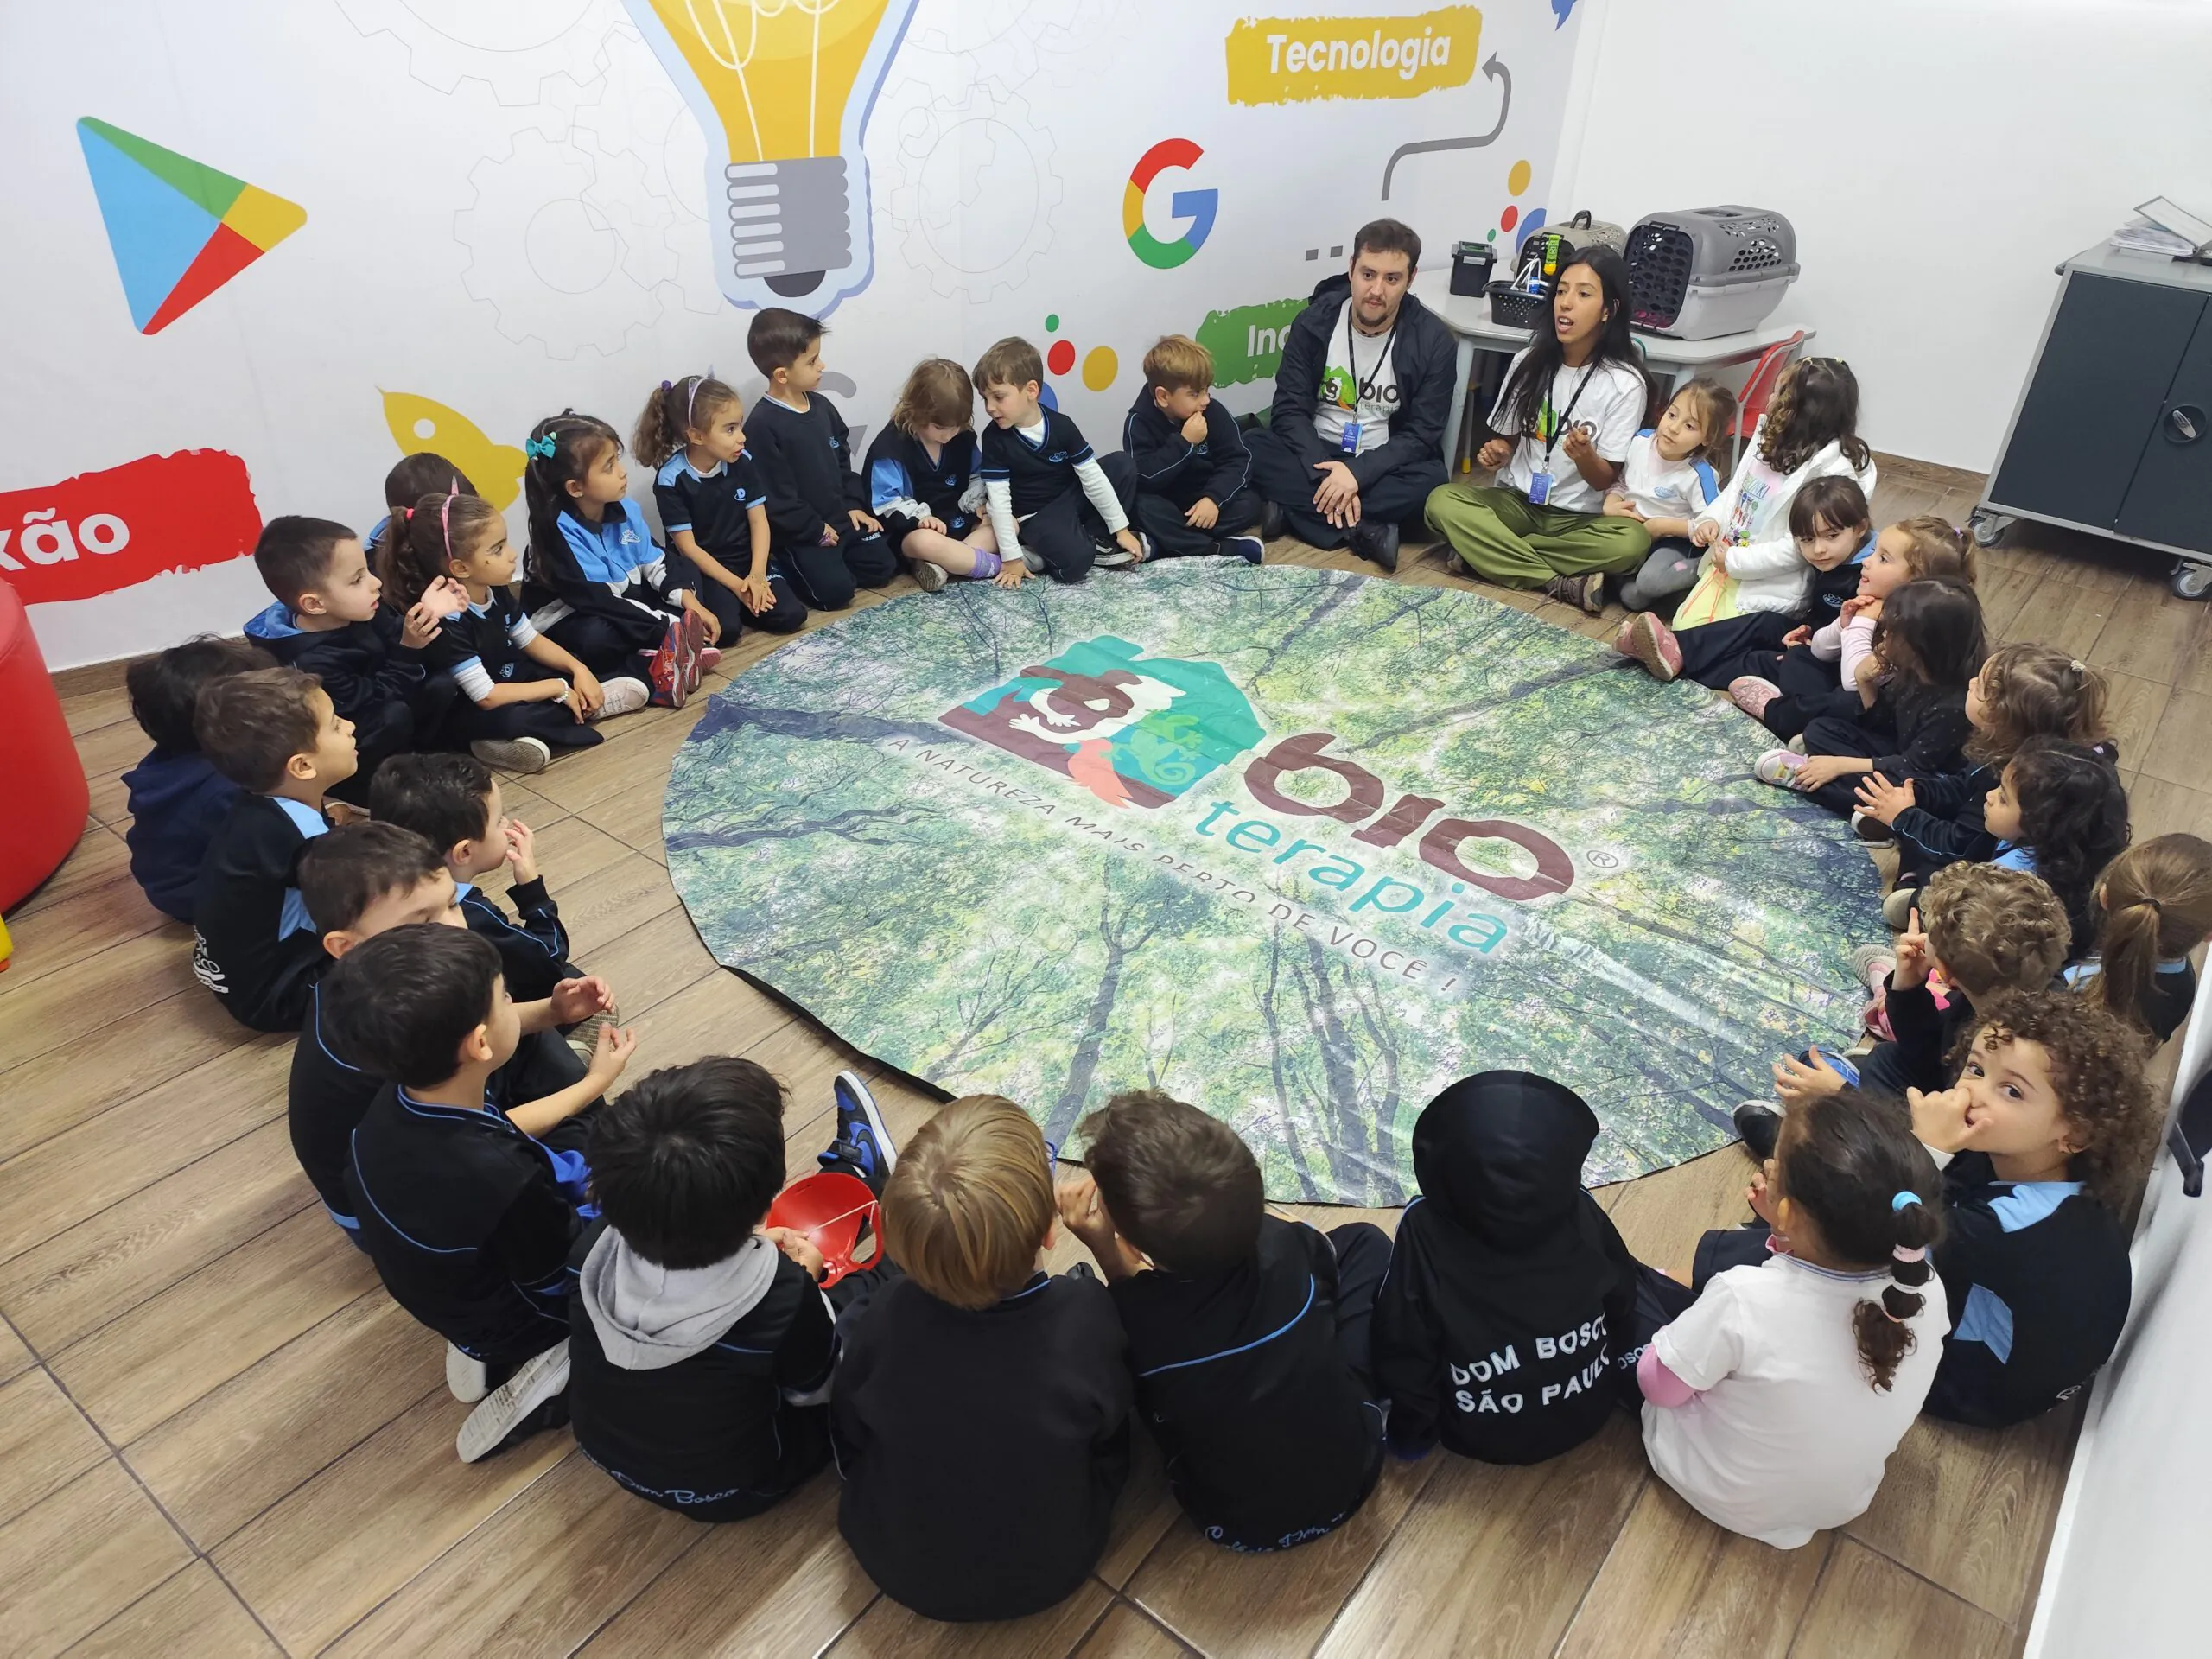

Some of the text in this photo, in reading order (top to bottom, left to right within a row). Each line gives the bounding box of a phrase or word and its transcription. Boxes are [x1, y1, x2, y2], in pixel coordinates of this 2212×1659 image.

[1267, 26, 1452, 80] Tecnologia
[887, 738, 910, 752] A
[915, 749, 1057, 816] NATUREZA
[1065, 816, 1145, 853] MAIS
[1268, 903, 1316, 932] DE
[1329, 925, 1428, 980] VOCÊ
[1243, 732, 1575, 901] bio
[1194, 800, 1509, 954] terapia
[1449, 1344, 1521, 1386] DOM
[1455, 1389, 1524, 1414] SÃO
